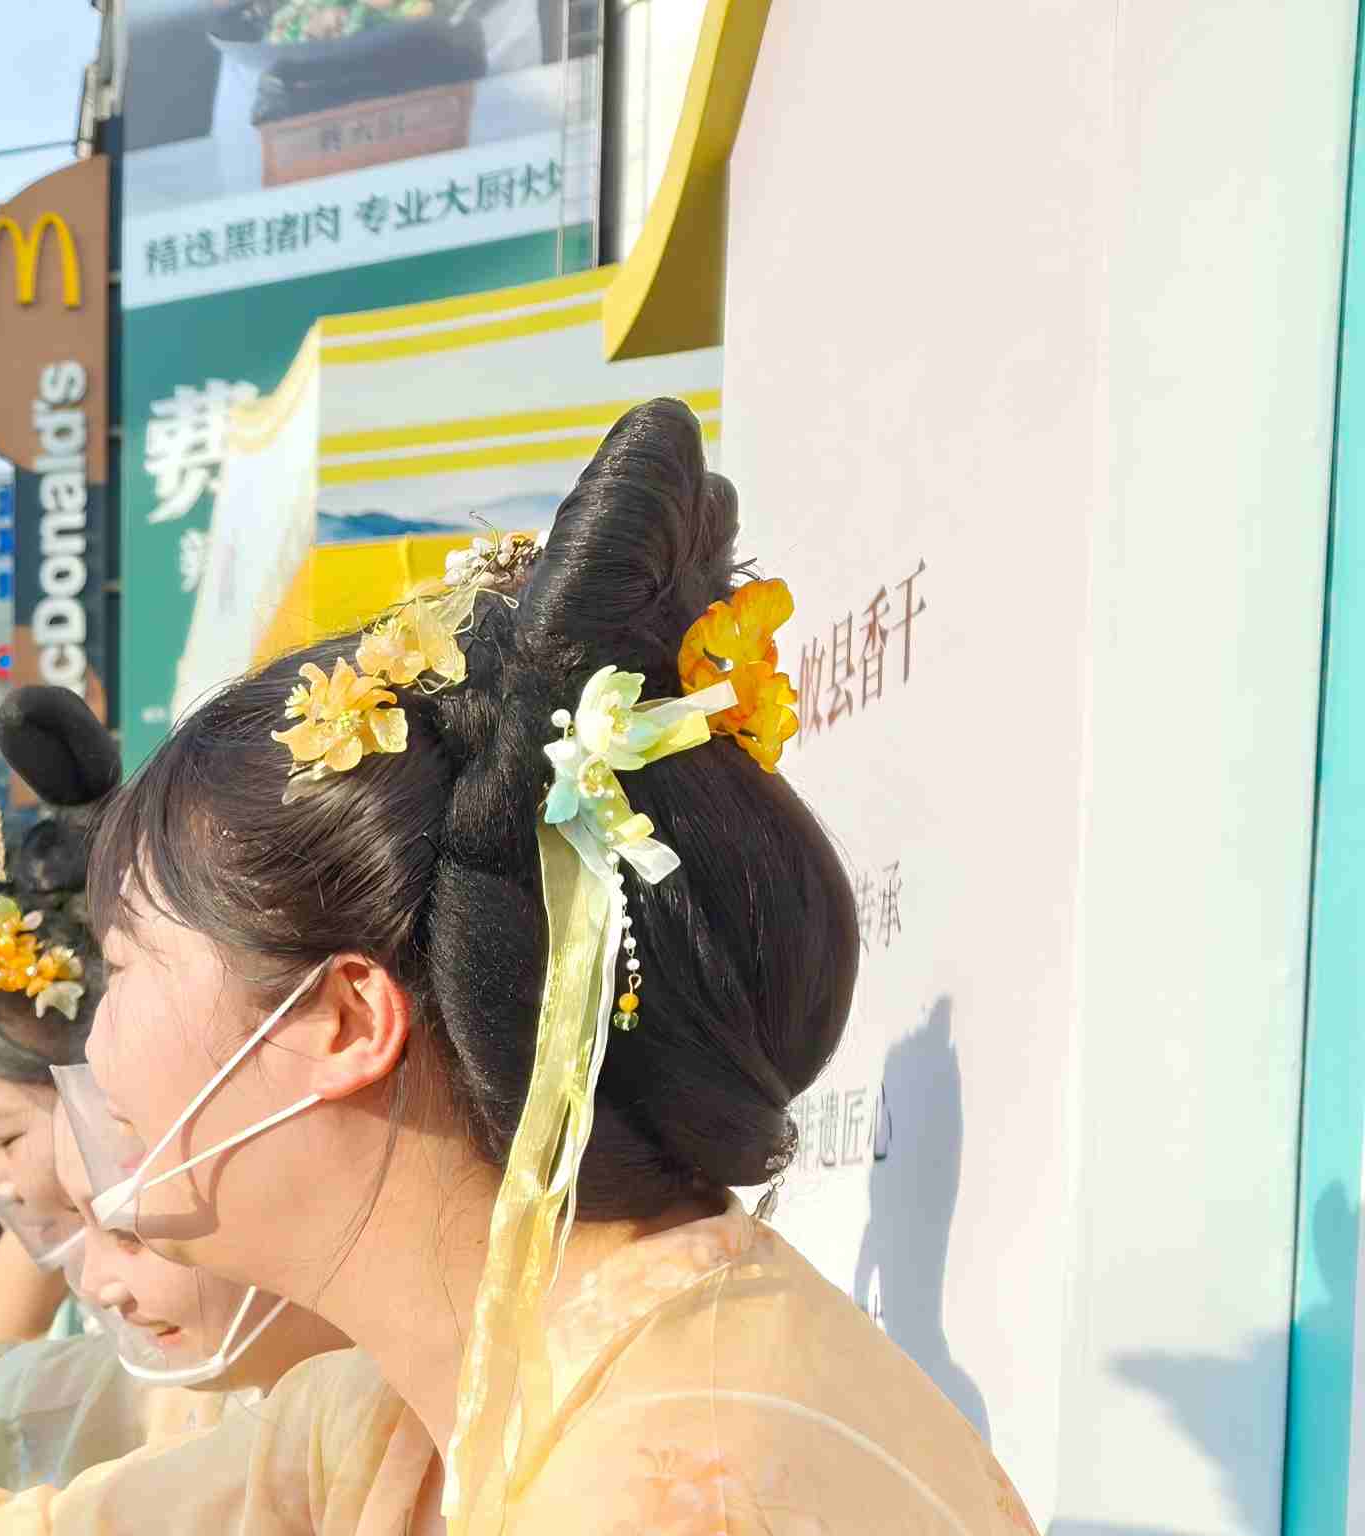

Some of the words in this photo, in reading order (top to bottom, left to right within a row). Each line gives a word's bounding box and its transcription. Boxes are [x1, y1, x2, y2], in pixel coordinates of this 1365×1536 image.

[144, 204, 343, 278] 精选黑猪肉
[32, 358, 87, 699] cDonald's
[797, 556, 926, 751] 攸县香干
